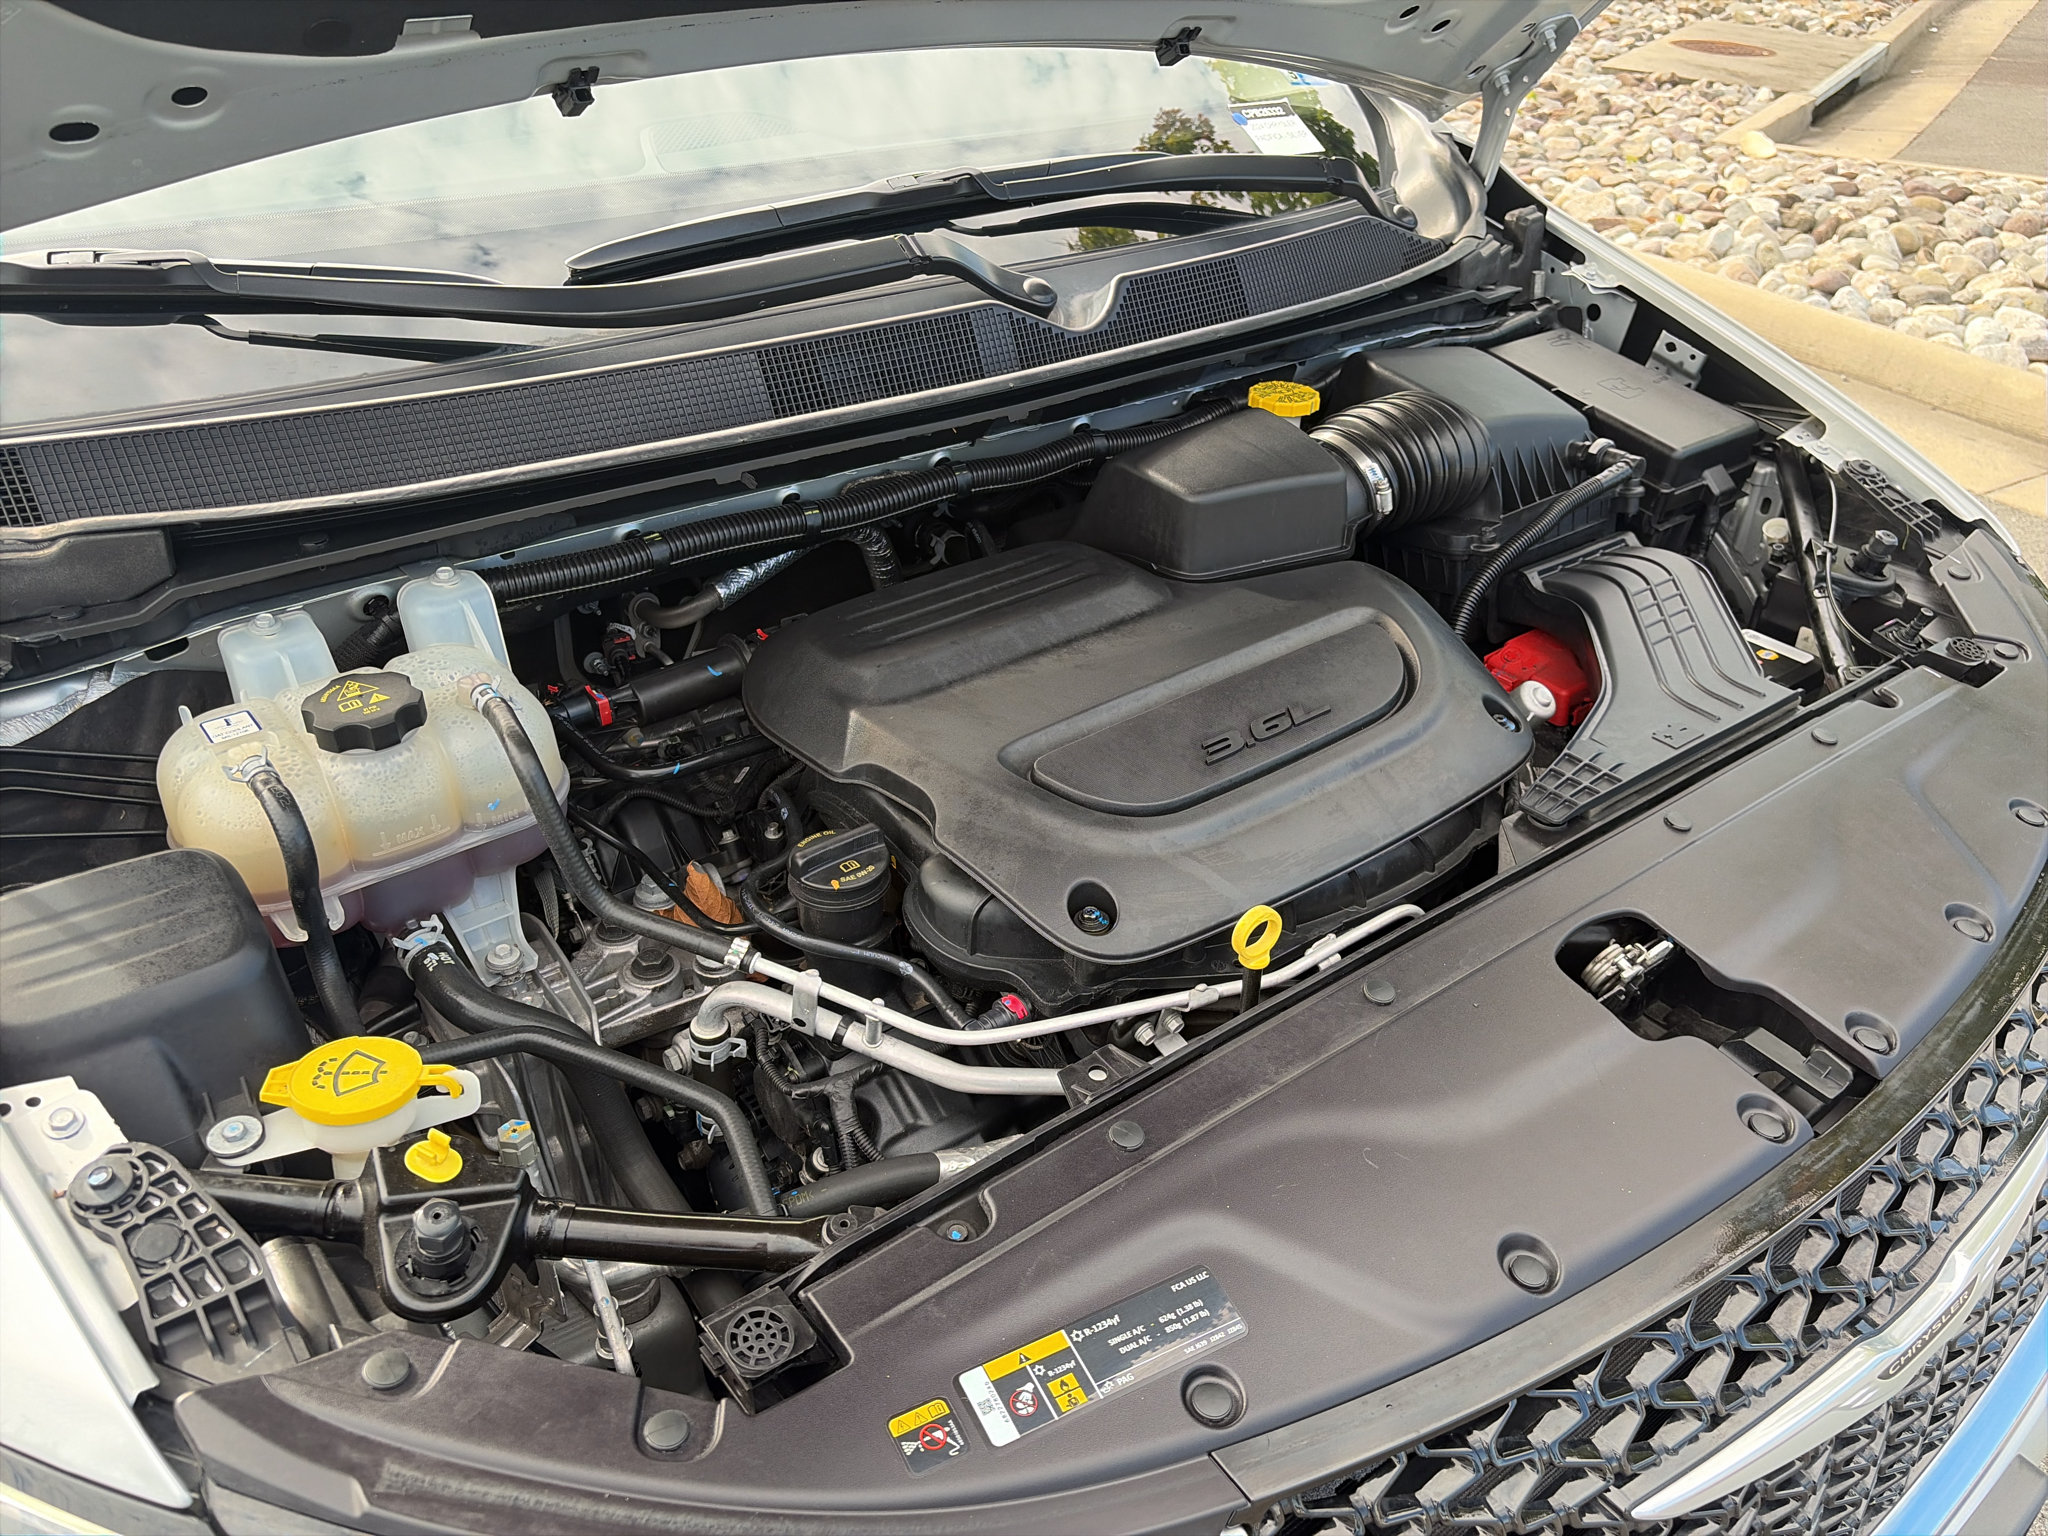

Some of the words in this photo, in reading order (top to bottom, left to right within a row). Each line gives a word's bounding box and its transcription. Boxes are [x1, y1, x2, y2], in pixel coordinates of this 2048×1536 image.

[1202, 704, 1331, 766] 3.6L
[797, 832, 822, 848] ENGINE
[840, 874, 856, 883] SAE
[1171, 1281, 1187, 1293] FCA
[1185, 1276, 1197, 1286] US
[1195, 1271, 1210, 1282] LLC
[1082, 1314, 1121, 1337] R-1234yf
[1107, 1330, 1133, 1346] SINGLE
[1133, 1325, 1147, 1336] A/C
[1889, 1291, 1969, 1375] CHRYSLER
[1119, 1342, 1140, 1355] DUAL
[1138, 1335, 1153, 1346] A/C
[1047, 1360, 1077, 1377] R-1234yf
[1116, 1373, 1135, 1386] PAG
